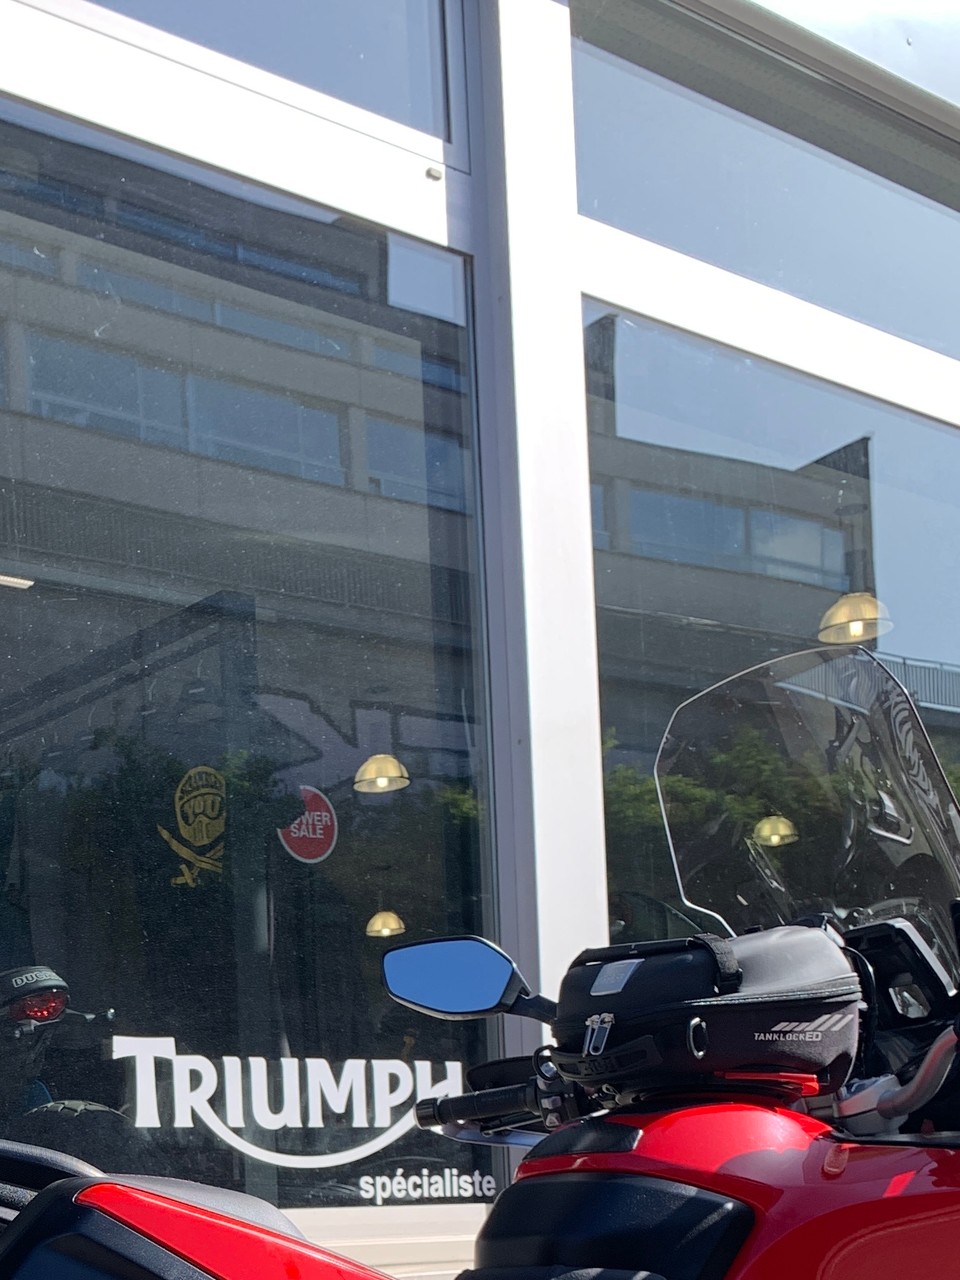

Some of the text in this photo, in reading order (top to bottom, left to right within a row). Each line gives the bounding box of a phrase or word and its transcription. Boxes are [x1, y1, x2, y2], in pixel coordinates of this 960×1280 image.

[290, 824, 324, 838] SALE
[753, 1031, 822, 1042] TANKLOCKED
[113, 1036, 462, 1168] TRIUMPH
[359, 1167, 497, 1205] spécialiste
